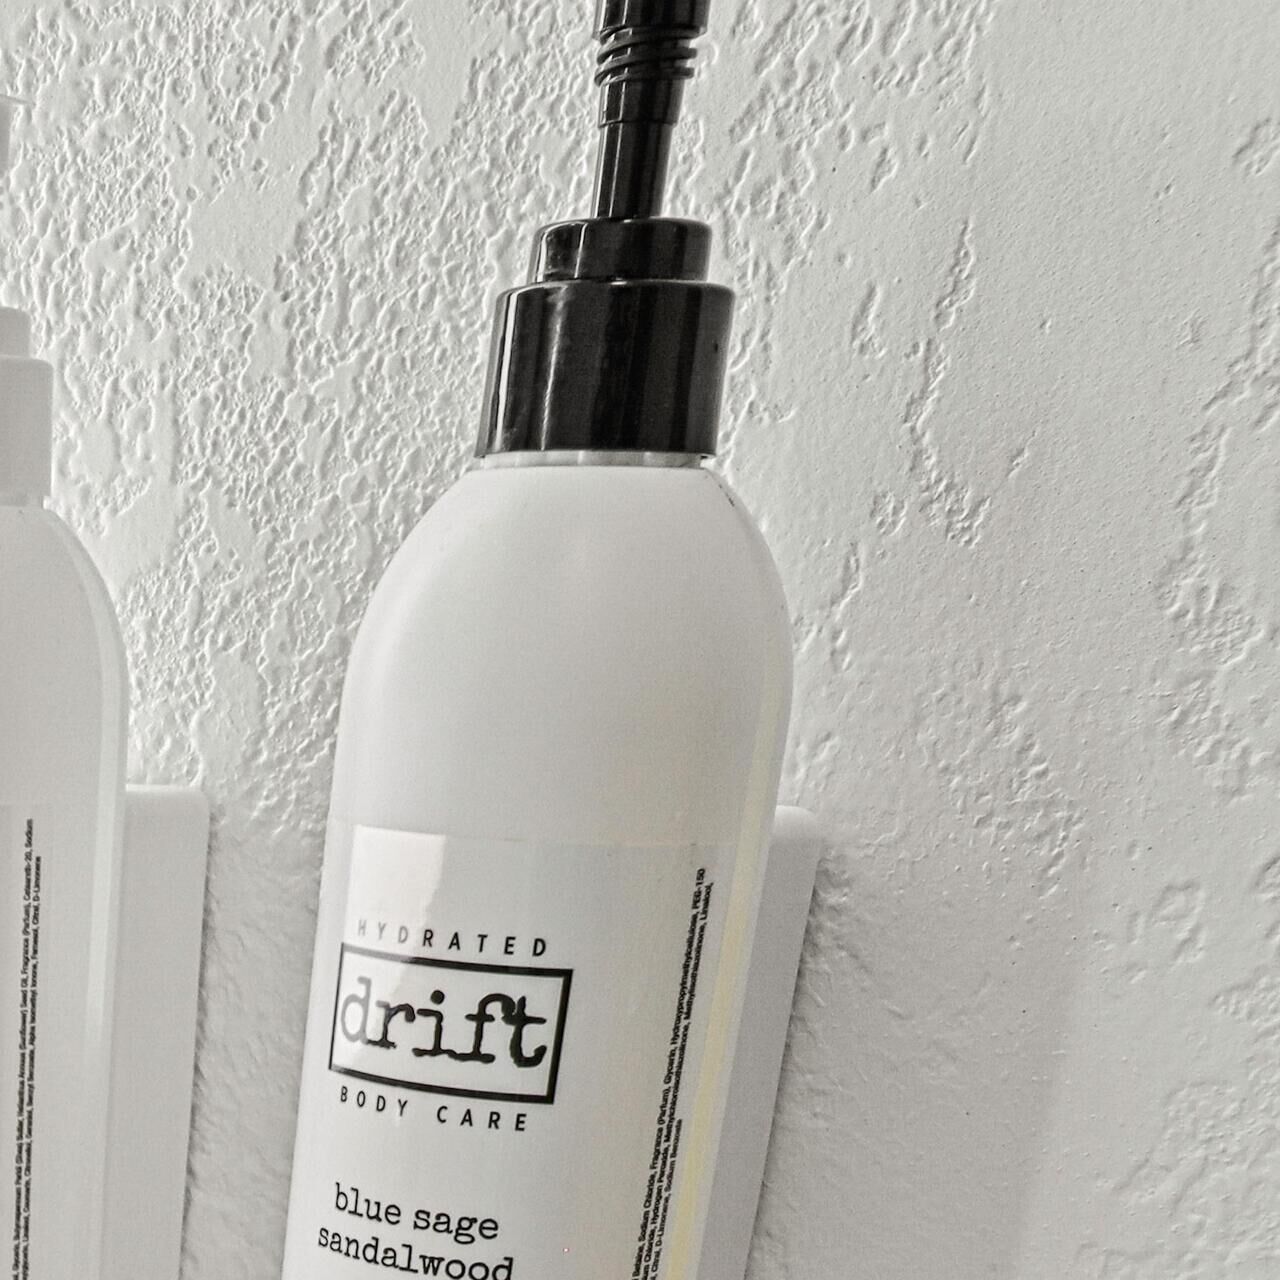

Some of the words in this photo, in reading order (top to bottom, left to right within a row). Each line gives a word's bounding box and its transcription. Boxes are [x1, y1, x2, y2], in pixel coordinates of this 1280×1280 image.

[357, 919, 547, 958] HYDRATED
[340, 975, 548, 1068] drift
[339, 1085, 409, 1117] BODY
[436, 1105, 528, 1132] CARE
[334, 1182, 402, 1226] blue
[412, 1208, 499, 1245] sage
